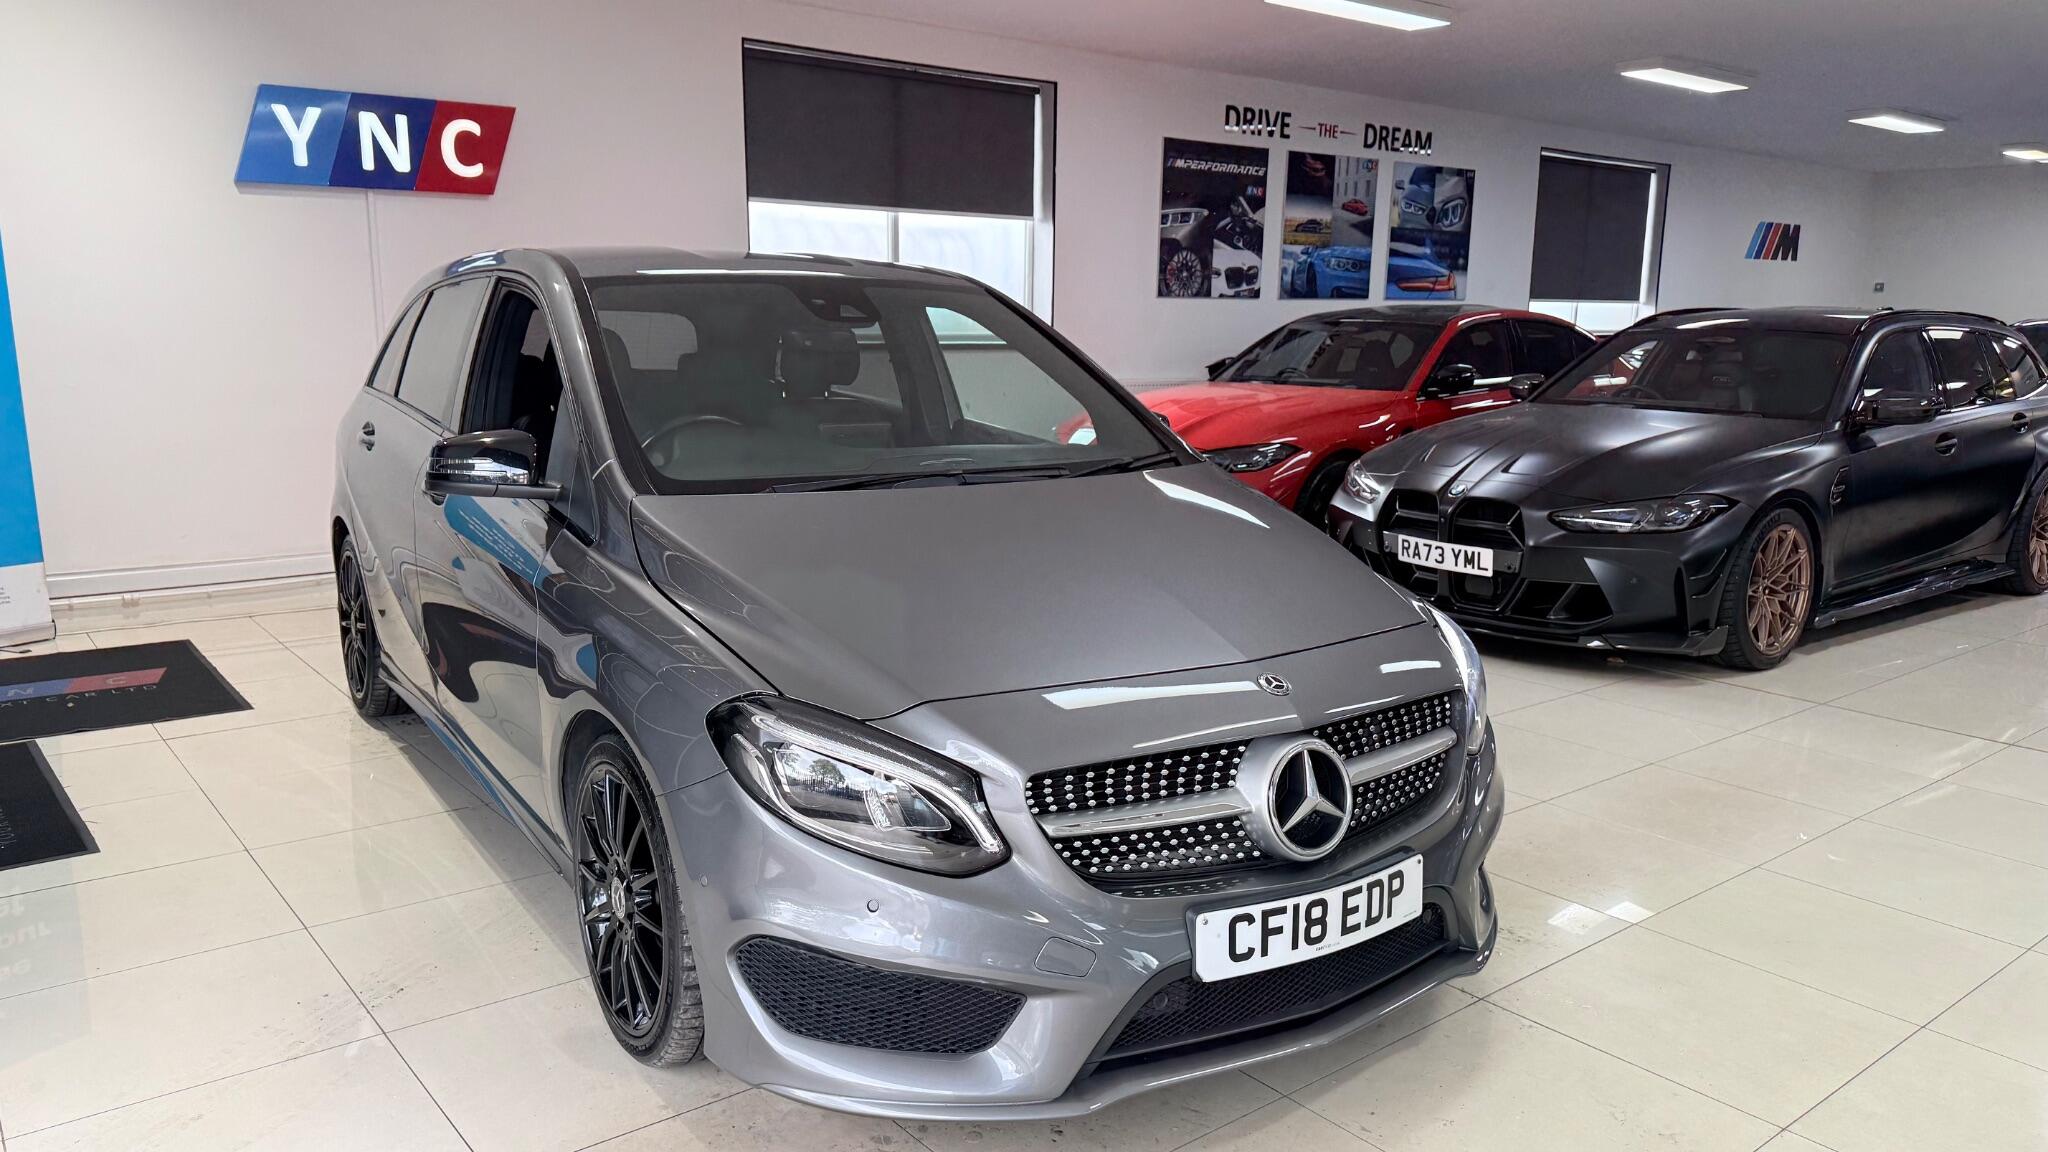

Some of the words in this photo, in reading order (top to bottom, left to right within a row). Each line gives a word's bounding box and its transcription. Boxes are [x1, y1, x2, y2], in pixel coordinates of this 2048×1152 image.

[271, 103, 484, 178] YNC
[1224, 104, 1292, 139] DRIVE
[1318, 123, 1339, 139] THE
[1363, 123, 1433, 156] DREAM
[1402, 539, 1444, 564] RA73
[1451, 548, 1489, 571] YML
[1229, 898, 1328, 963] CF18
[1341, 869, 1405, 936] EDP
